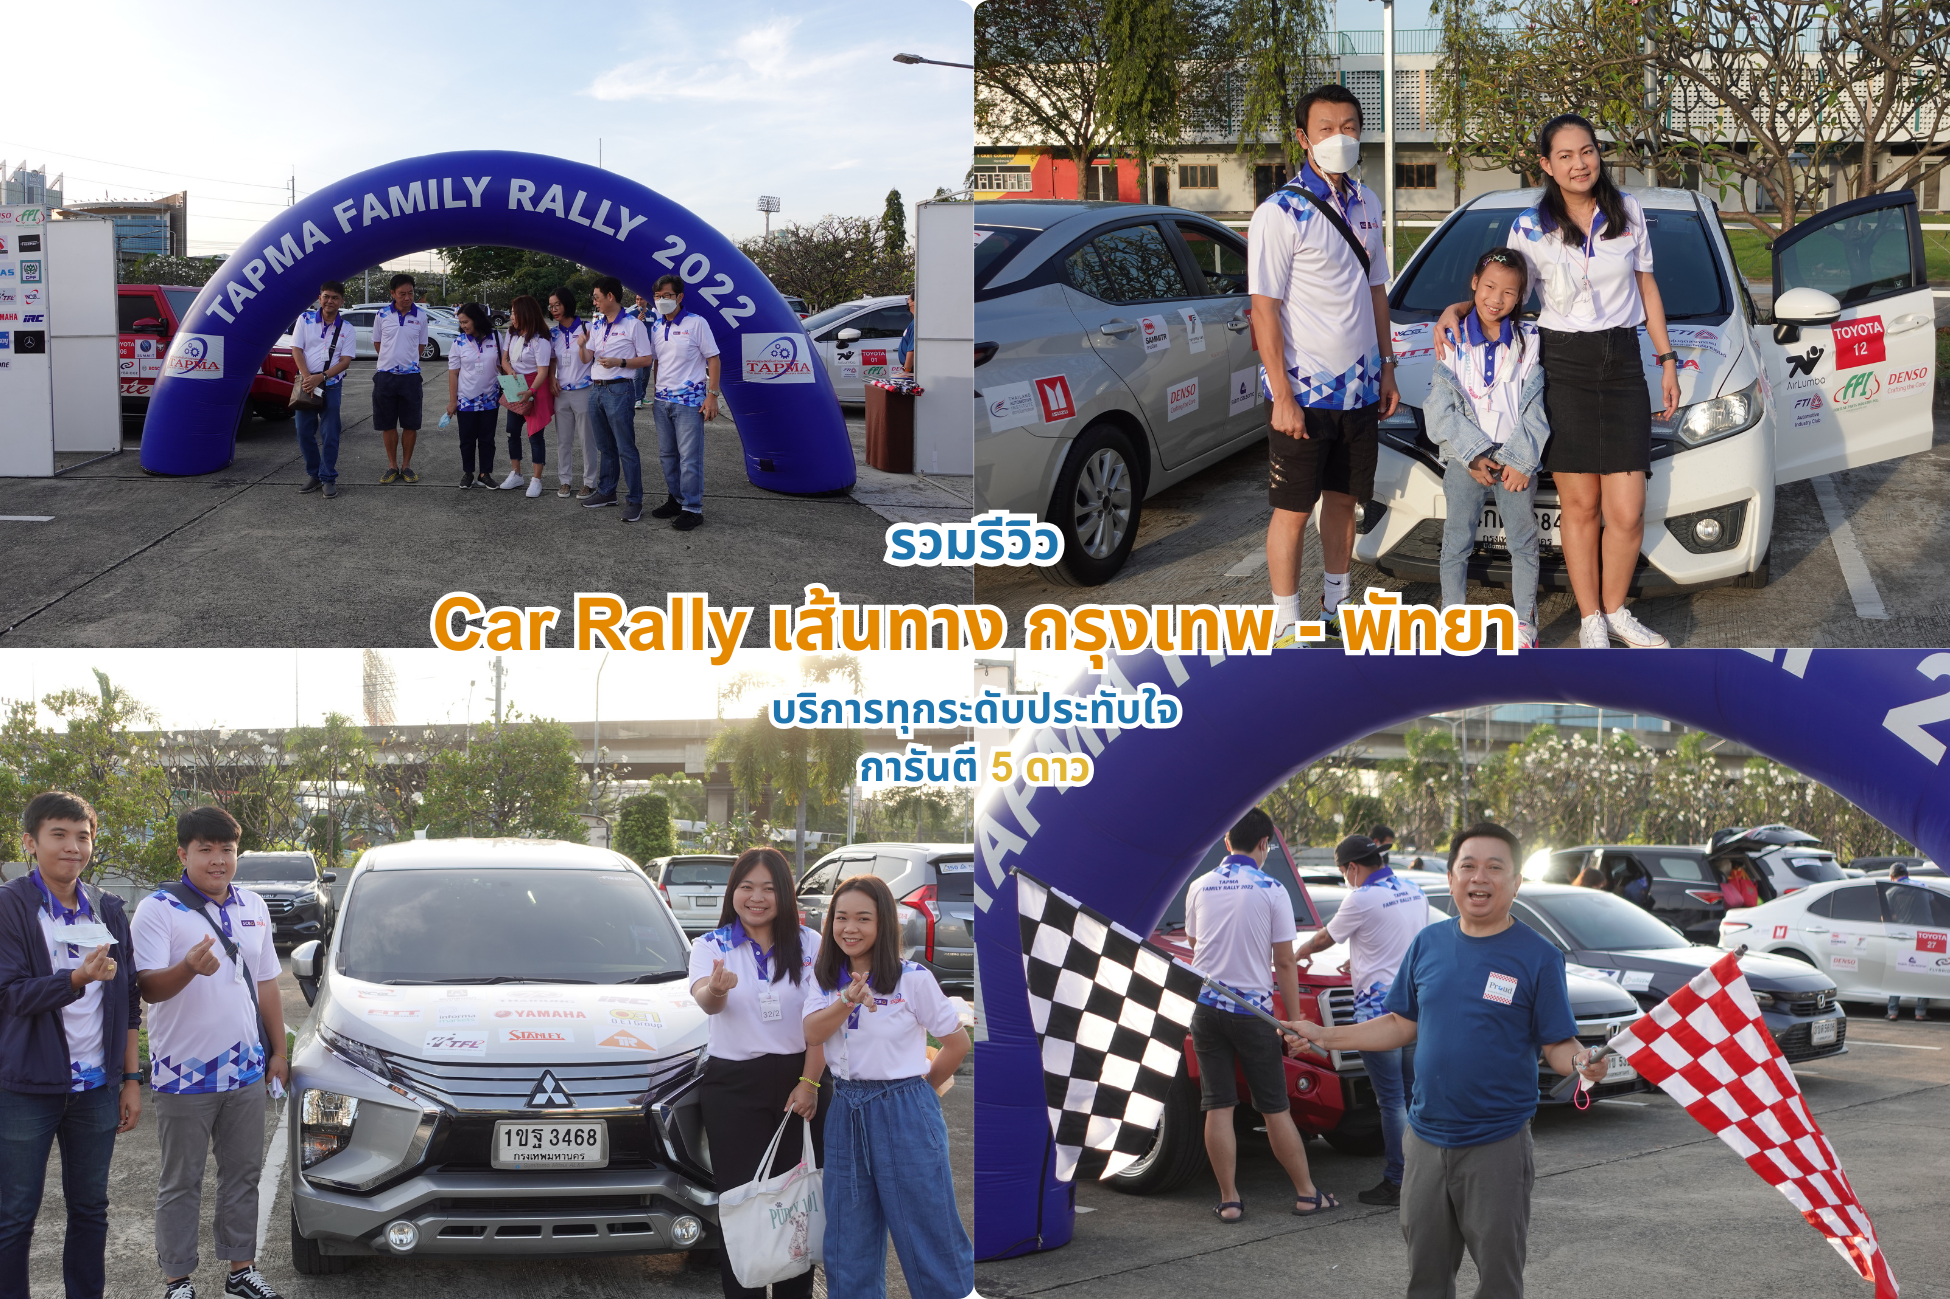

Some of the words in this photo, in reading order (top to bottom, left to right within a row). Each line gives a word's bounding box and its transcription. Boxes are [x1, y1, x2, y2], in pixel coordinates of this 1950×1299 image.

[206, 219, 332, 325] TAPMA
[333, 176, 492, 234] FAMILY
[508, 178, 648, 242] RALLY
[652, 234, 756, 330] 2022
[23, 314, 44, 323] IRC
[1833, 321, 1883, 340] TOYOTA
[1853, 341, 1868, 356] 12
[169, 358, 220, 370] TAPMA
[746, 362, 811, 374] TAPMA
[1888, 366, 1928, 386] DENSO
[1786, 377, 1826, 391] AirLumba
[1170, 383, 1196, 405] DENSO
[1793, 397, 1811, 410] FTI
[1917, 932, 1947, 942] TOYOTA
[1926, 941, 1937, 949] 27
[1489, 981, 1513, 995] Proud
[514, 1009, 588, 1019] YAMAHA
[762, 1009, 781, 1019] 32/2
[634, 1020, 663, 1029] Group
[508, 1029, 566, 1041] STANLEY
[504, 1128, 544, 1149] 1ขฐ
[549, 1128, 598, 1147] 3468
[801, 1190, 819, 1213] 101
